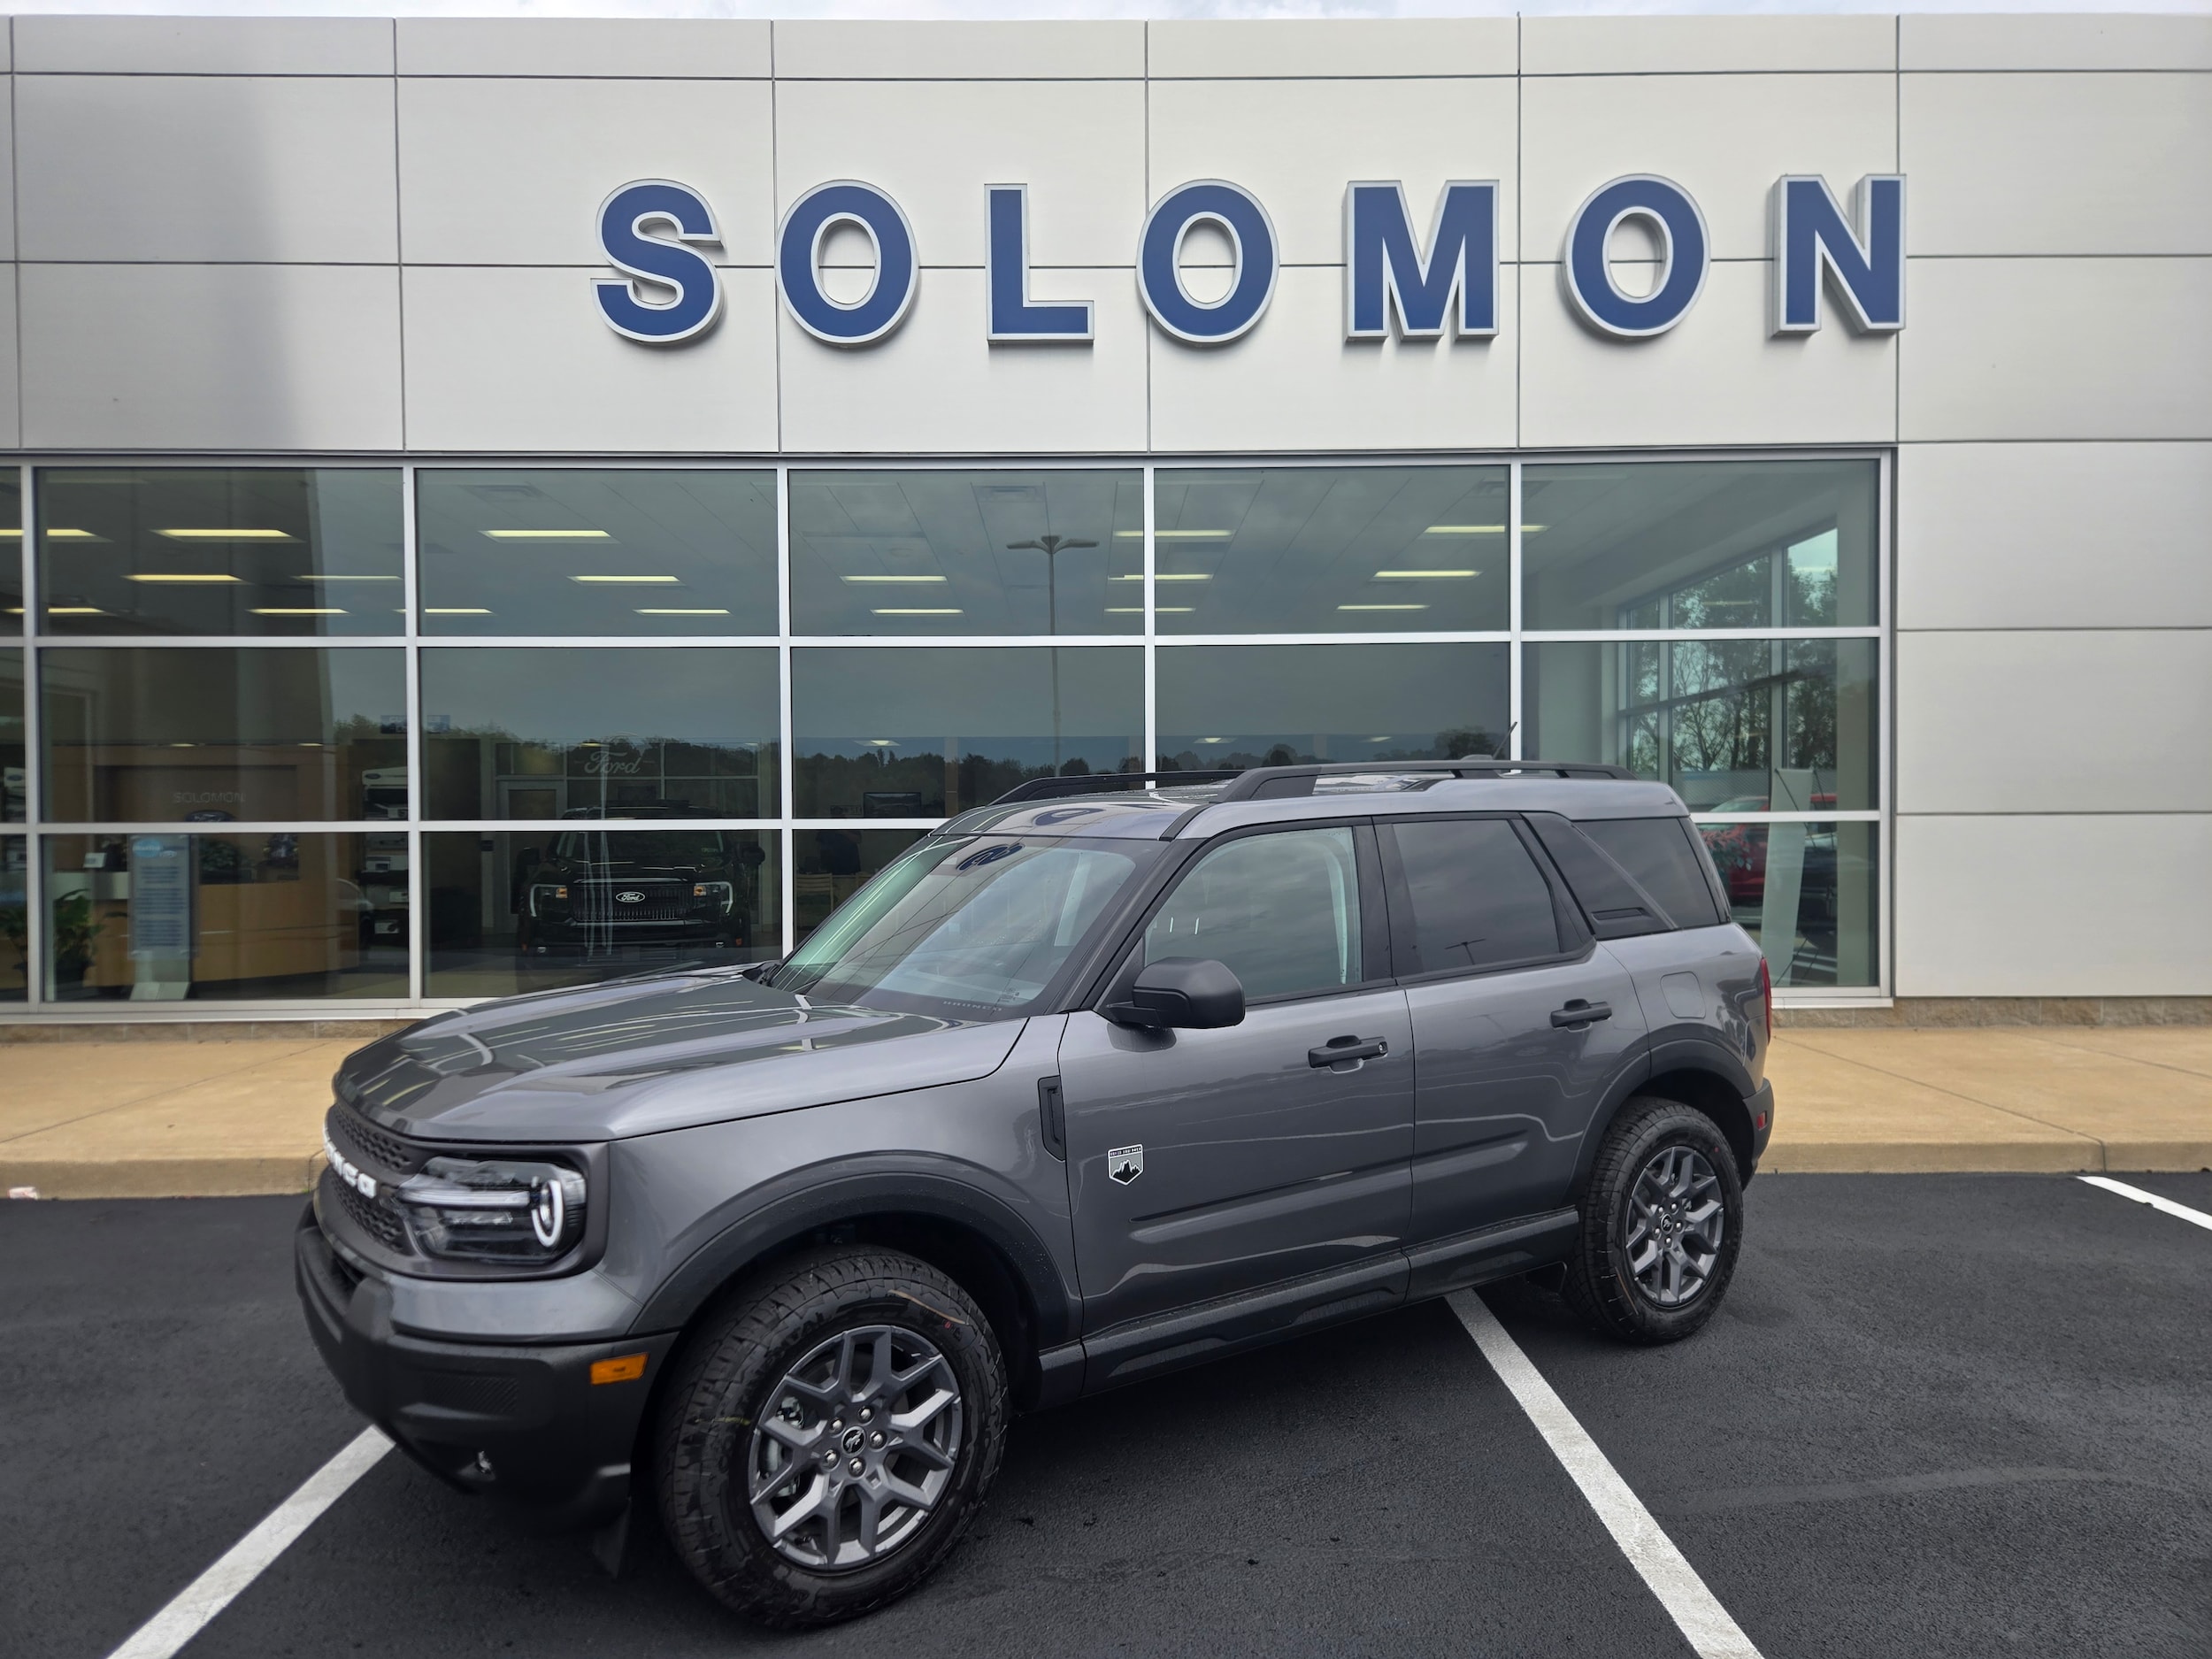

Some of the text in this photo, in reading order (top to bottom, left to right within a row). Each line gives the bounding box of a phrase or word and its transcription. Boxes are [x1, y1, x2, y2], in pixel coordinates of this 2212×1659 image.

[590, 173, 1907, 345] SOLOMON
[585, 751, 641, 774] Ford
[173, 791, 247, 803] SOLOMON
